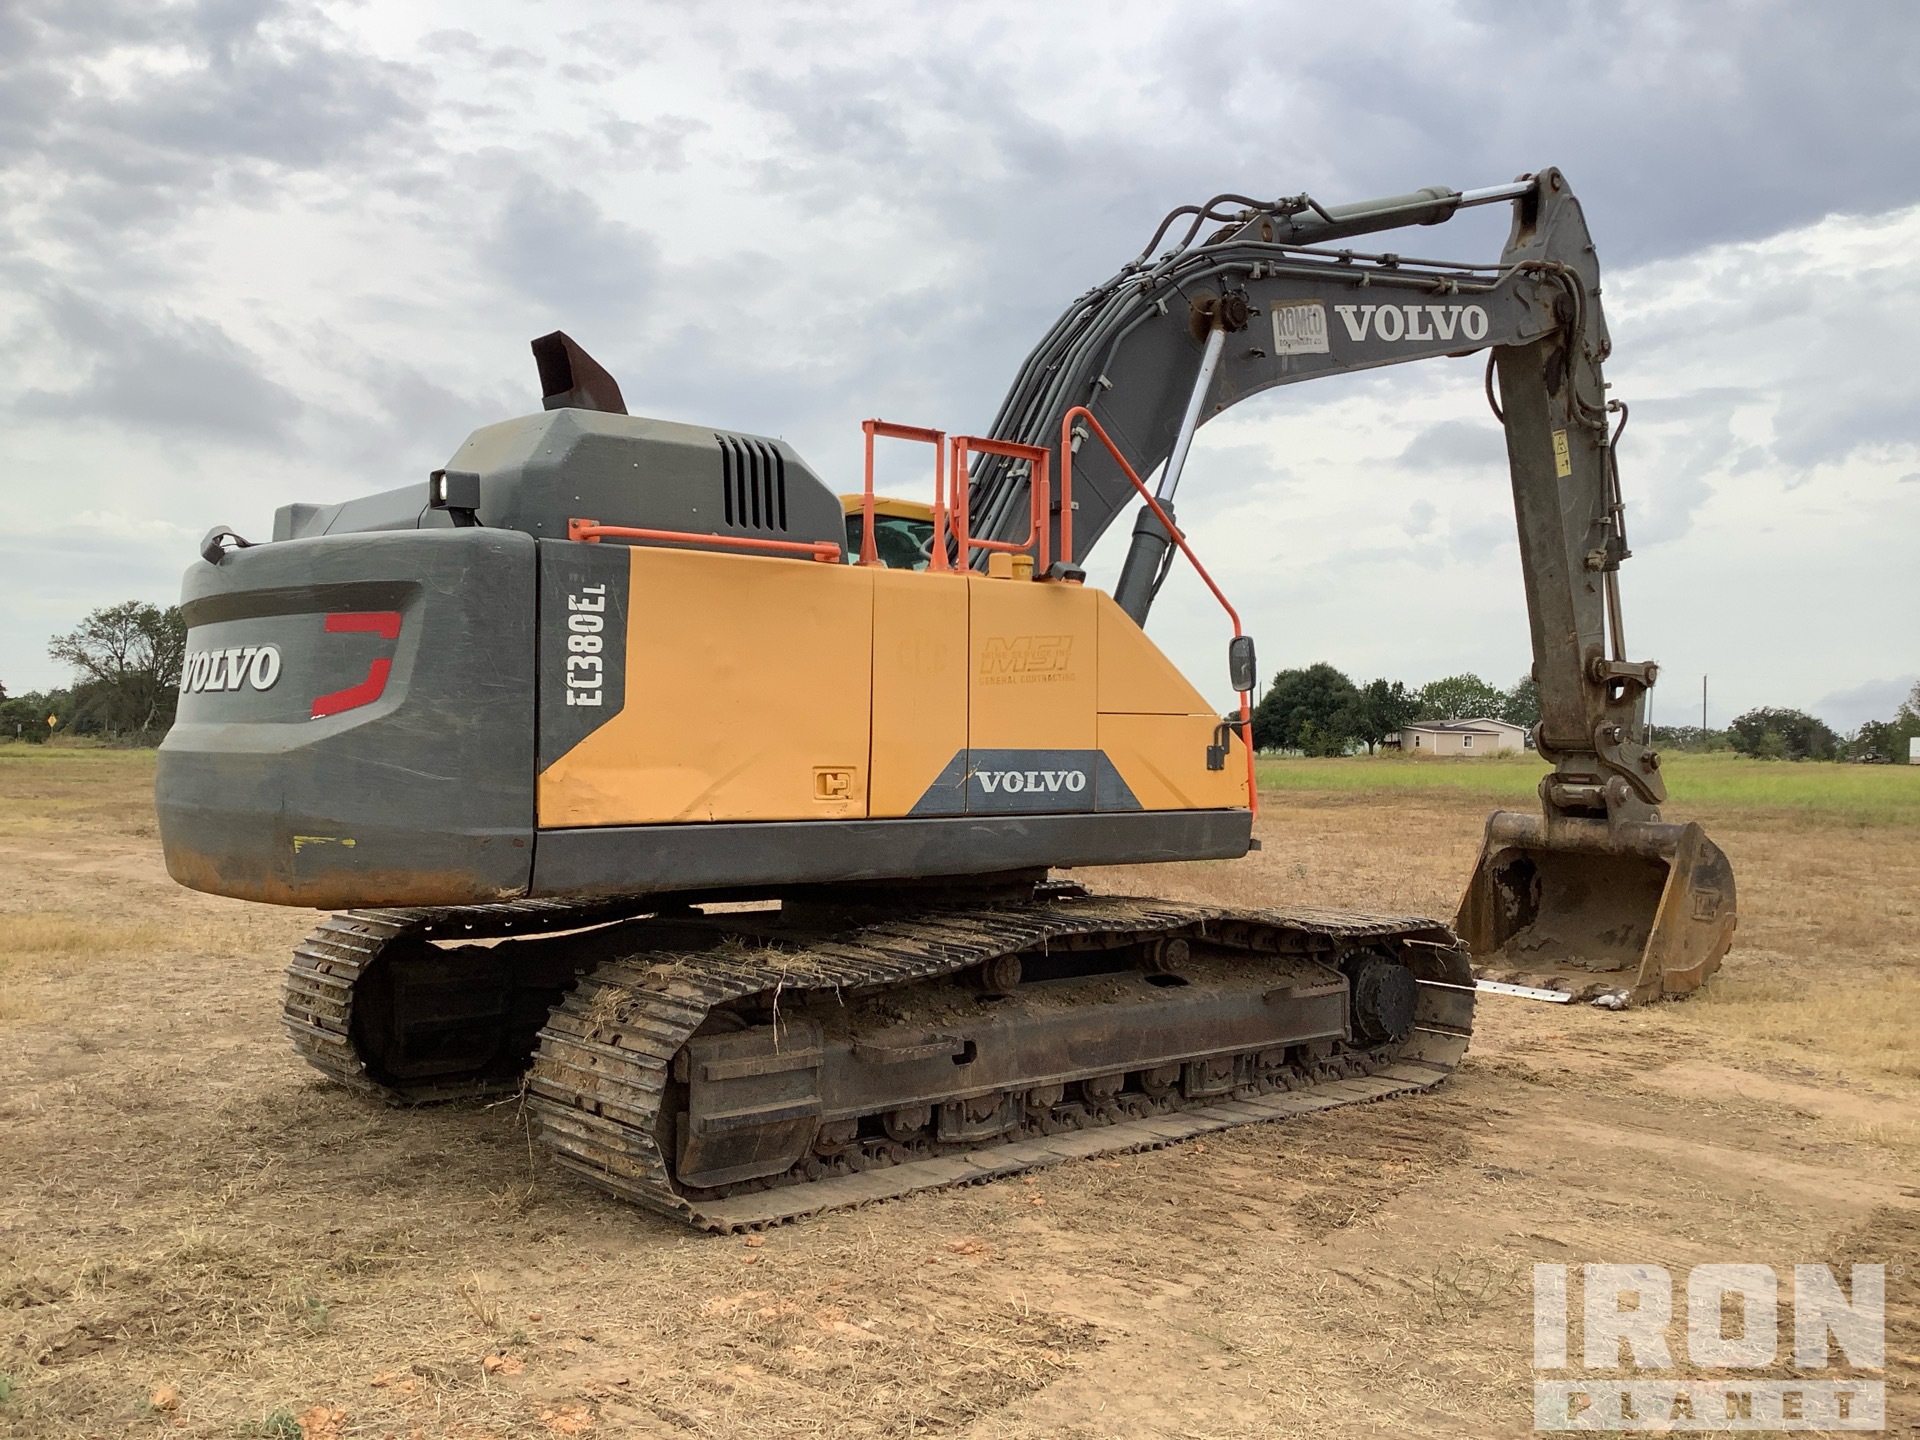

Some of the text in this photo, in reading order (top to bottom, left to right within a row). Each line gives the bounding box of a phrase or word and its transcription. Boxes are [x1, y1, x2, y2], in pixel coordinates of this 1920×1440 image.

[1334, 304, 1489, 341] VOLVO
[566, 584, 606, 706] EC380EL
[182, 646, 281, 693] VOLVO
[979, 673, 1076, 686] GENERAL CONTRACTING
[975, 770, 1086, 793] VOLVO
